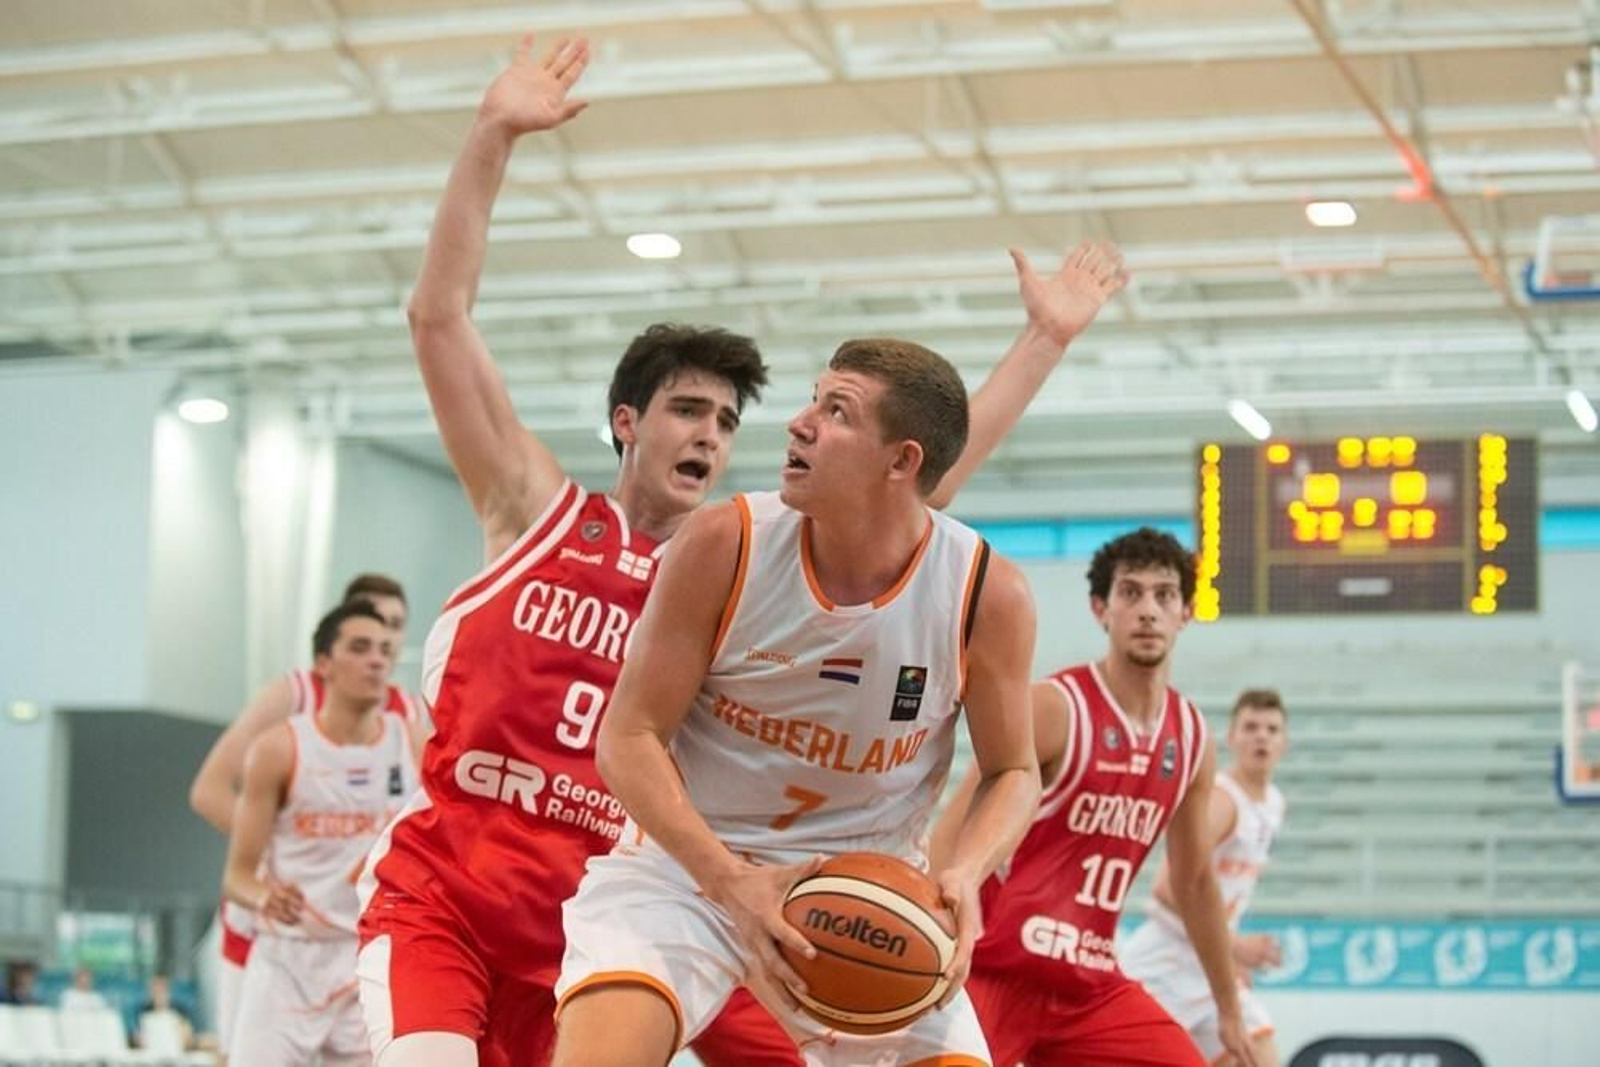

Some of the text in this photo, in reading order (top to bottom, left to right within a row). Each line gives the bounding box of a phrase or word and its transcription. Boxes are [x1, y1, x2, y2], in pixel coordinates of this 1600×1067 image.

[555, 680, 606, 750] 9
[714, 693, 929, 775] NEDERLAND
[454, 749, 547, 815] GR
[768, 784, 829, 832] 7
[545, 797, 623, 841] Railwa
[1074, 854, 1133, 913] 10
[805, 906, 908, 958] molten
[1020, 913, 1080, 966] GR
